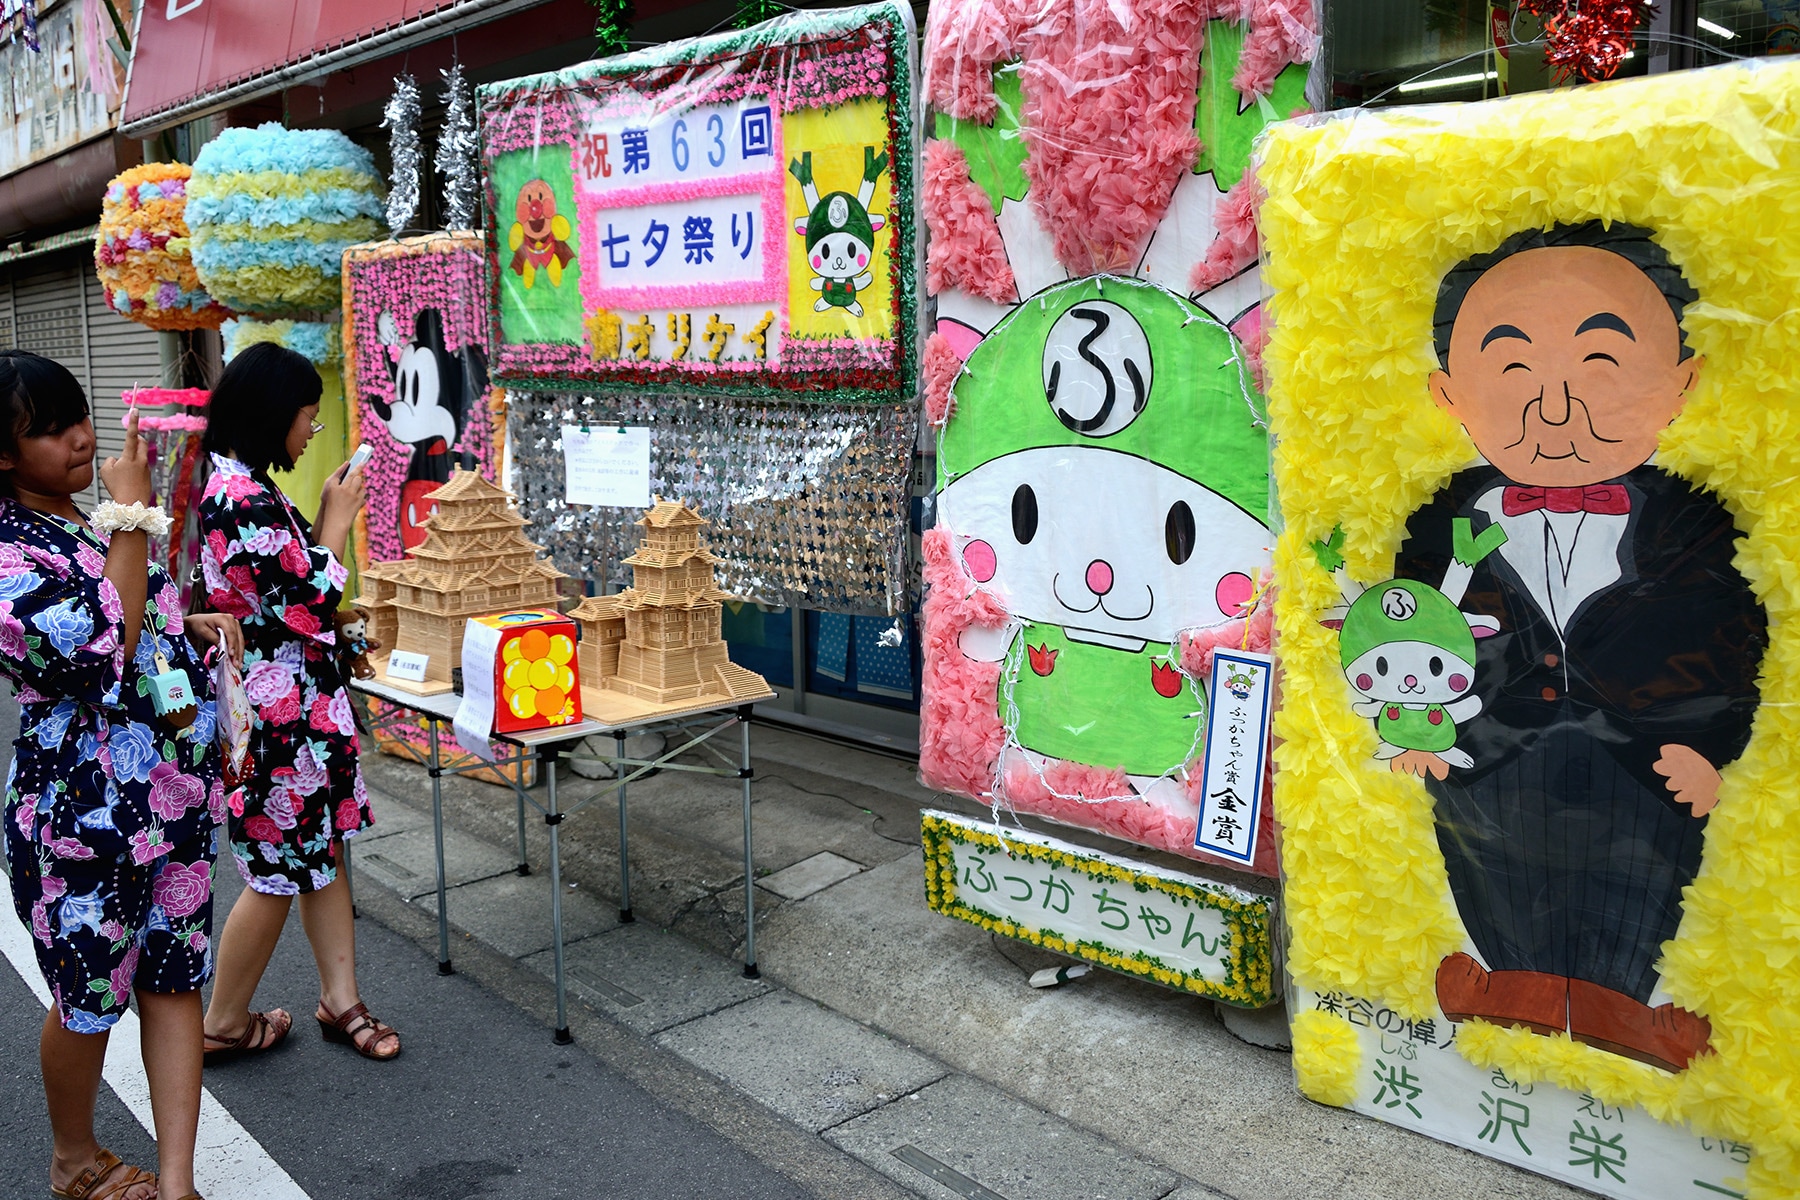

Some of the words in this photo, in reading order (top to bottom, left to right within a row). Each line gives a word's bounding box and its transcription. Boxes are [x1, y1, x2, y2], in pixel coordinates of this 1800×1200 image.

[601, 211, 753, 268] 七夕祭り
[587, 308, 775, 361] オリケイ
[1045, 308, 1145, 432] ふ
[1224, 706, 1248, 785] ふっかちゃん賞
[1210, 787, 1247, 846] 金賞
[963, 855, 1219, 956] ふっかちゃん
[1380, 1033, 1418, 1061] しぶ
[1577, 1093, 1624, 1123] えい
